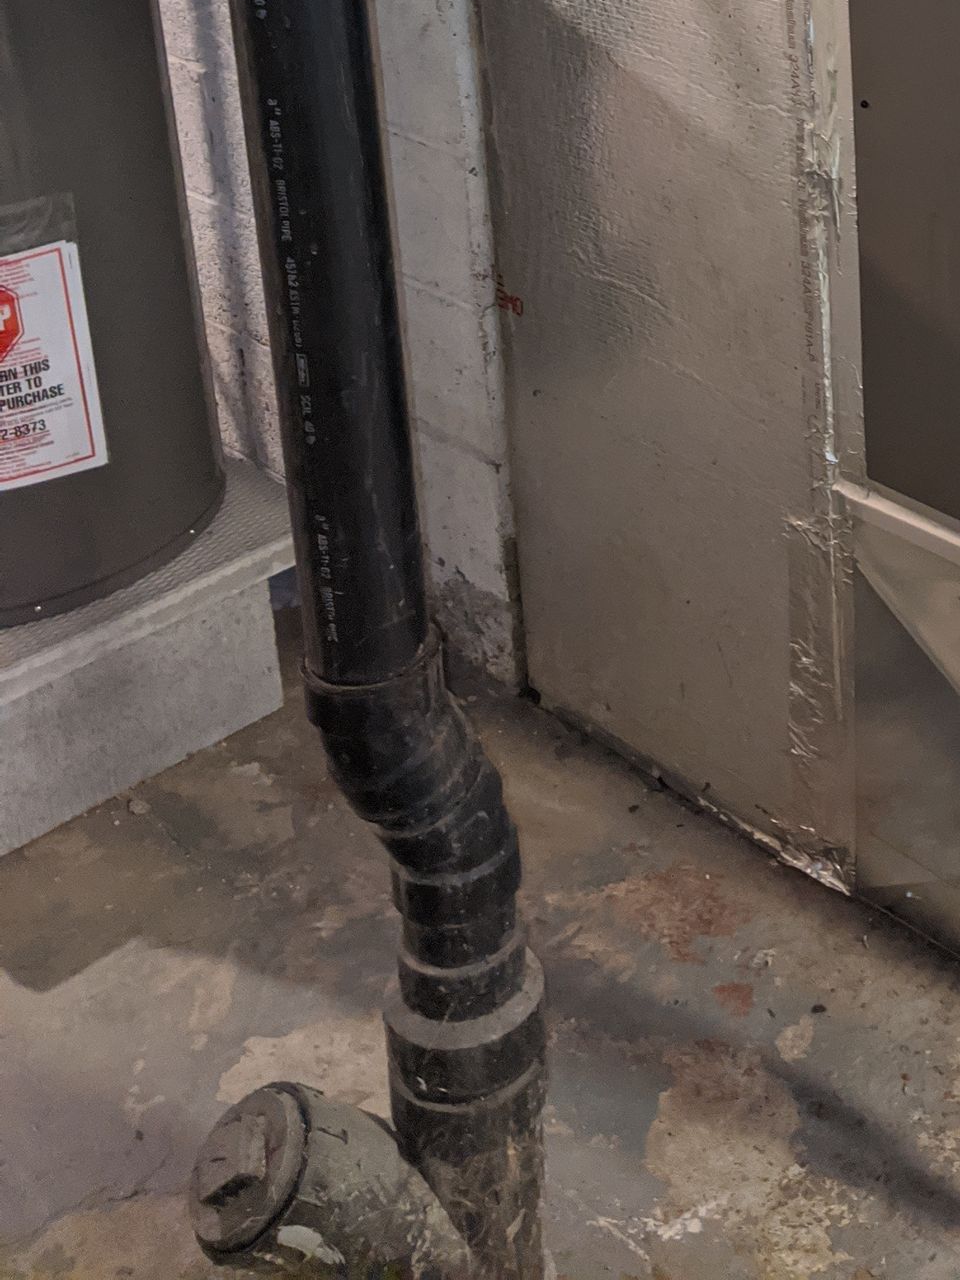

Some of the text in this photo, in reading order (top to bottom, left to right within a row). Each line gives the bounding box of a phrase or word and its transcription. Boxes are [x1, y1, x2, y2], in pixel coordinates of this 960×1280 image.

[281, 220, 293, 242] PIPE
[21, 358, 51, 377] THIS
[25, 375, 43, 391] TO
